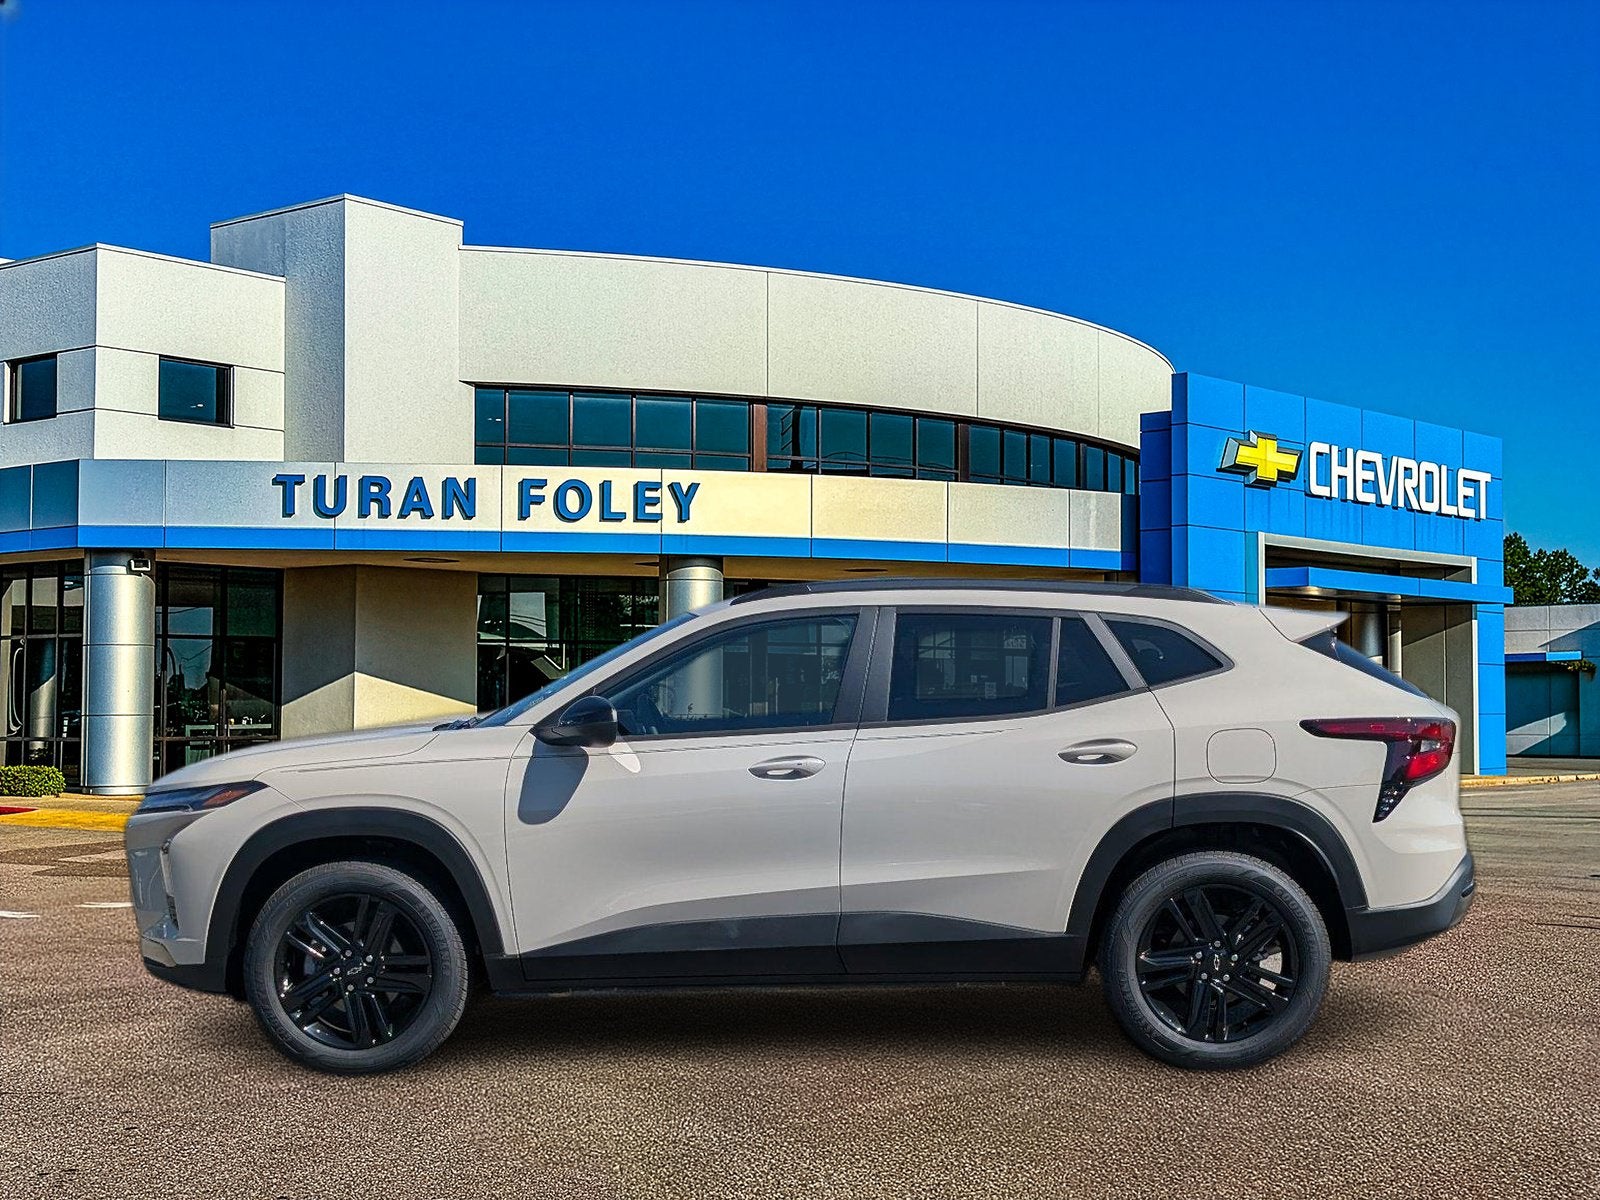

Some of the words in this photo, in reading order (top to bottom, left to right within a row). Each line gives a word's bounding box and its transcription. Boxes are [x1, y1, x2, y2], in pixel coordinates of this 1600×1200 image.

[272, 473, 476, 520] TURAN
[517, 478, 701, 523] FOLEY
[1307, 441, 1492, 521] CHEVROLET
